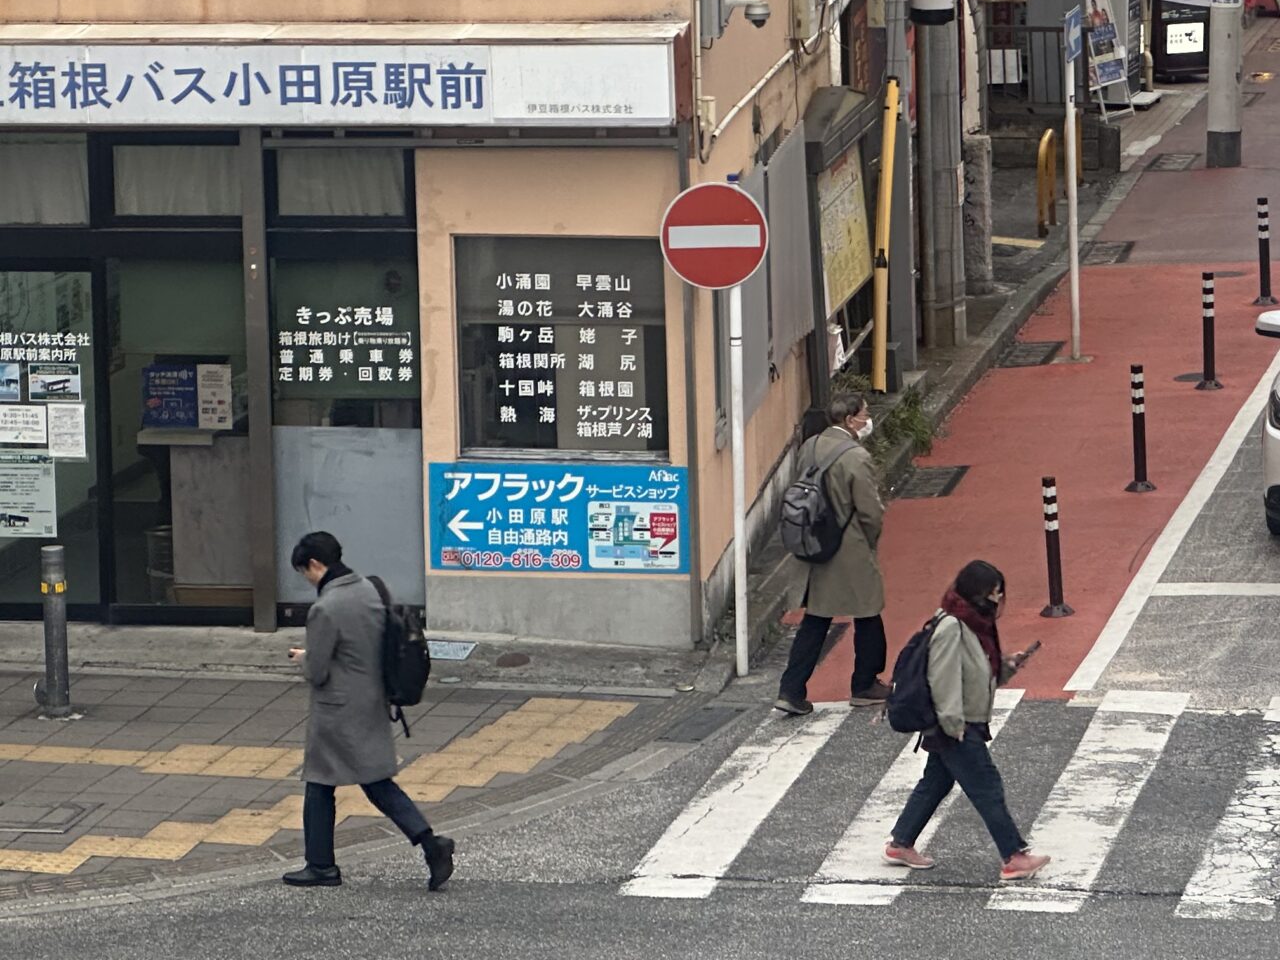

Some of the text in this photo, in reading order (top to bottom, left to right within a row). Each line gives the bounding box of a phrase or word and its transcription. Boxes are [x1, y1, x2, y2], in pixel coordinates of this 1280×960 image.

[0, 60, 487, 110] 箱根バス小田原駅前
[528, 104, 633, 115] 伊豆箱根バス株式会社
[496, 273, 550, 290] 小涌園
[576, 274, 631, 291] 早雲山
[296, 306, 393, 326] きっぷ売場
[498, 300, 553, 317] 湯の花
[578, 301, 632, 318] 大涌谷
[279, 331, 351, 346] 箱根旅助け
[579, 328, 637, 345] 姥子
[0, 348, 77, 361] 原駅前案内所
[279, 349, 413, 364] 普通乗車券
[499, 353, 566, 369] 箱根関所
[578, 354, 636, 371] 湖尻
[279, 366, 413, 381] 定期券・回数券
[499, 380, 554, 396] 十国峠
[579, 380, 633, 397] 箱根園
[500, 406, 555, 423] 熱海
[577, 405, 652, 421] ザ・プリンス
[577, 421, 652, 438] 箱根芦ノ湖
[444, 472, 584, 502] アフラック
[586, 484, 680, 499] サービスショップ
[486, 508, 569, 525] 小田原駅
[488, 529, 569, 546] 自由通路内
[462, 552, 581, 568] 0120-816-309
